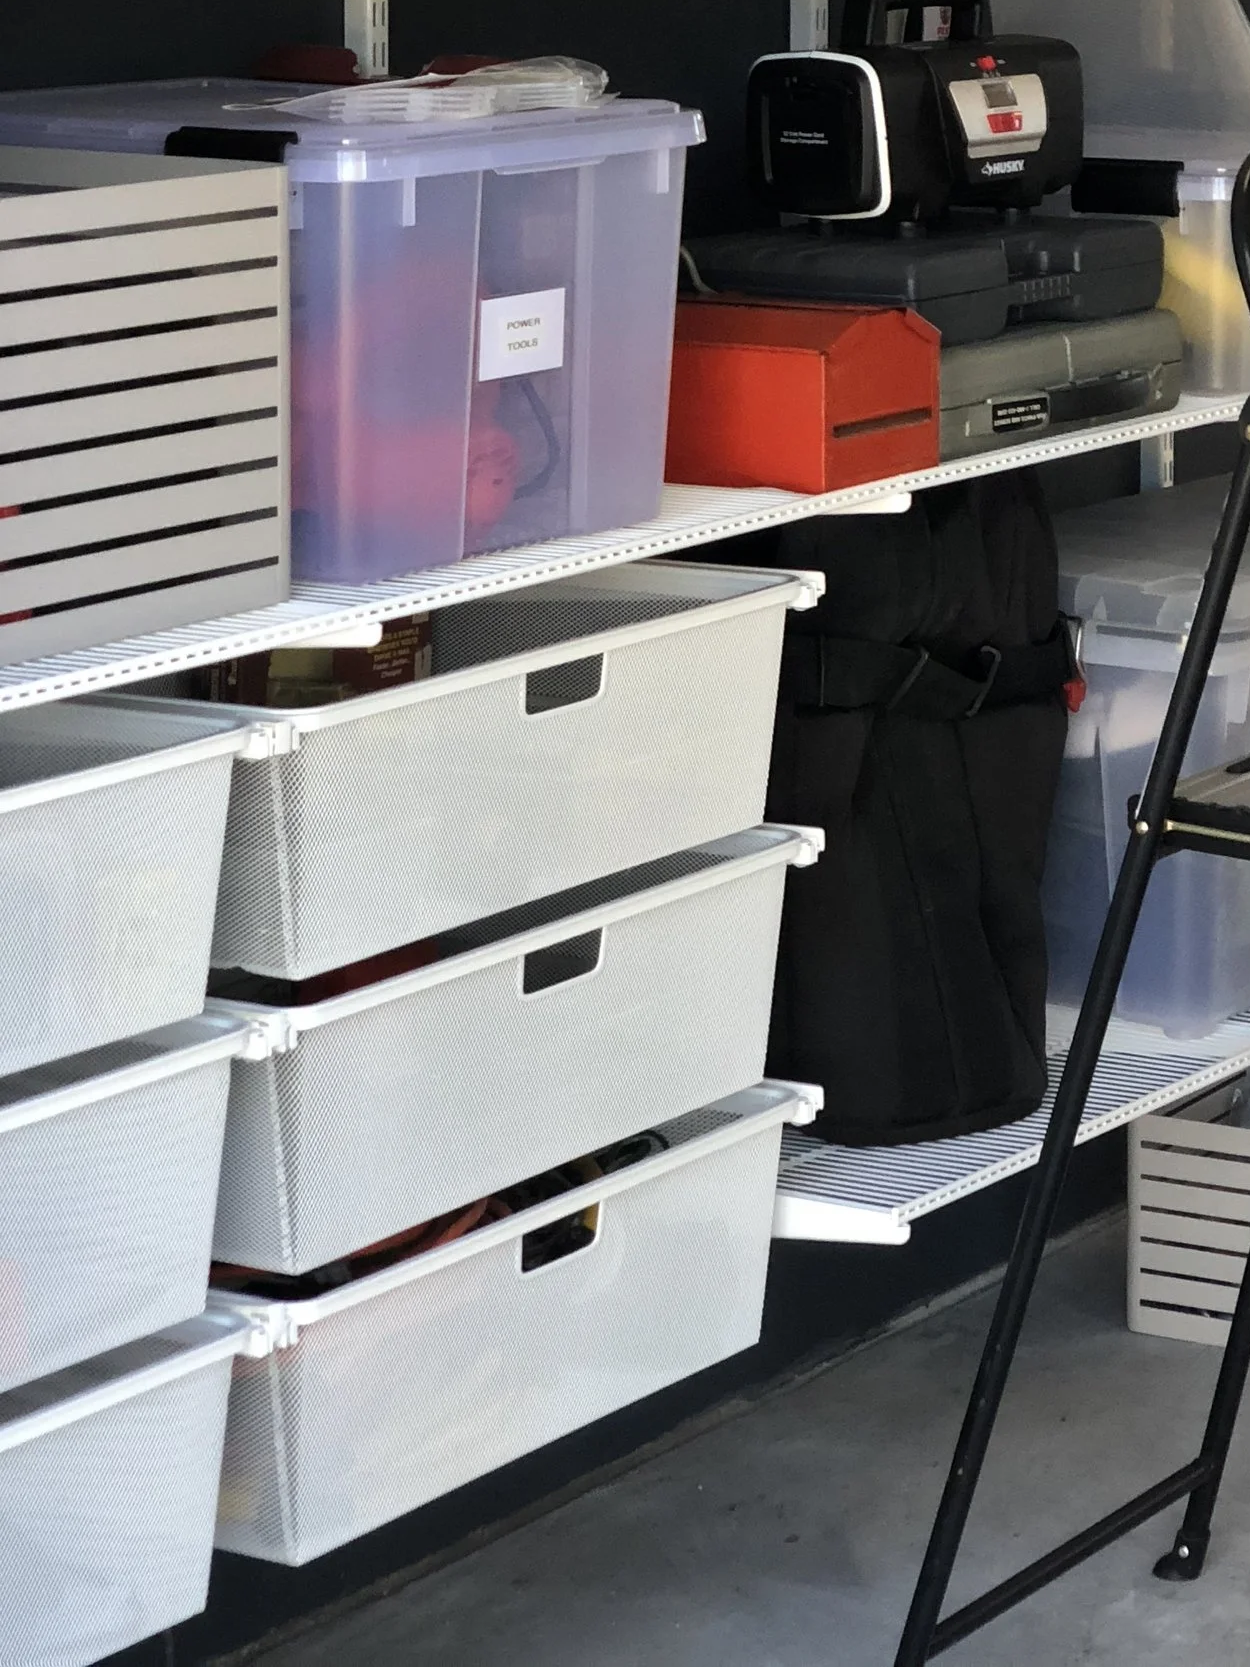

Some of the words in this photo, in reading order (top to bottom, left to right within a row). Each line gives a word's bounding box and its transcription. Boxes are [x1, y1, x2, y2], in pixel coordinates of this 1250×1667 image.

[993, 159, 1025, 175] HUSKY
[506, 317, 541, 331] POWER
[507, 337, 538, 351] TOOLS
